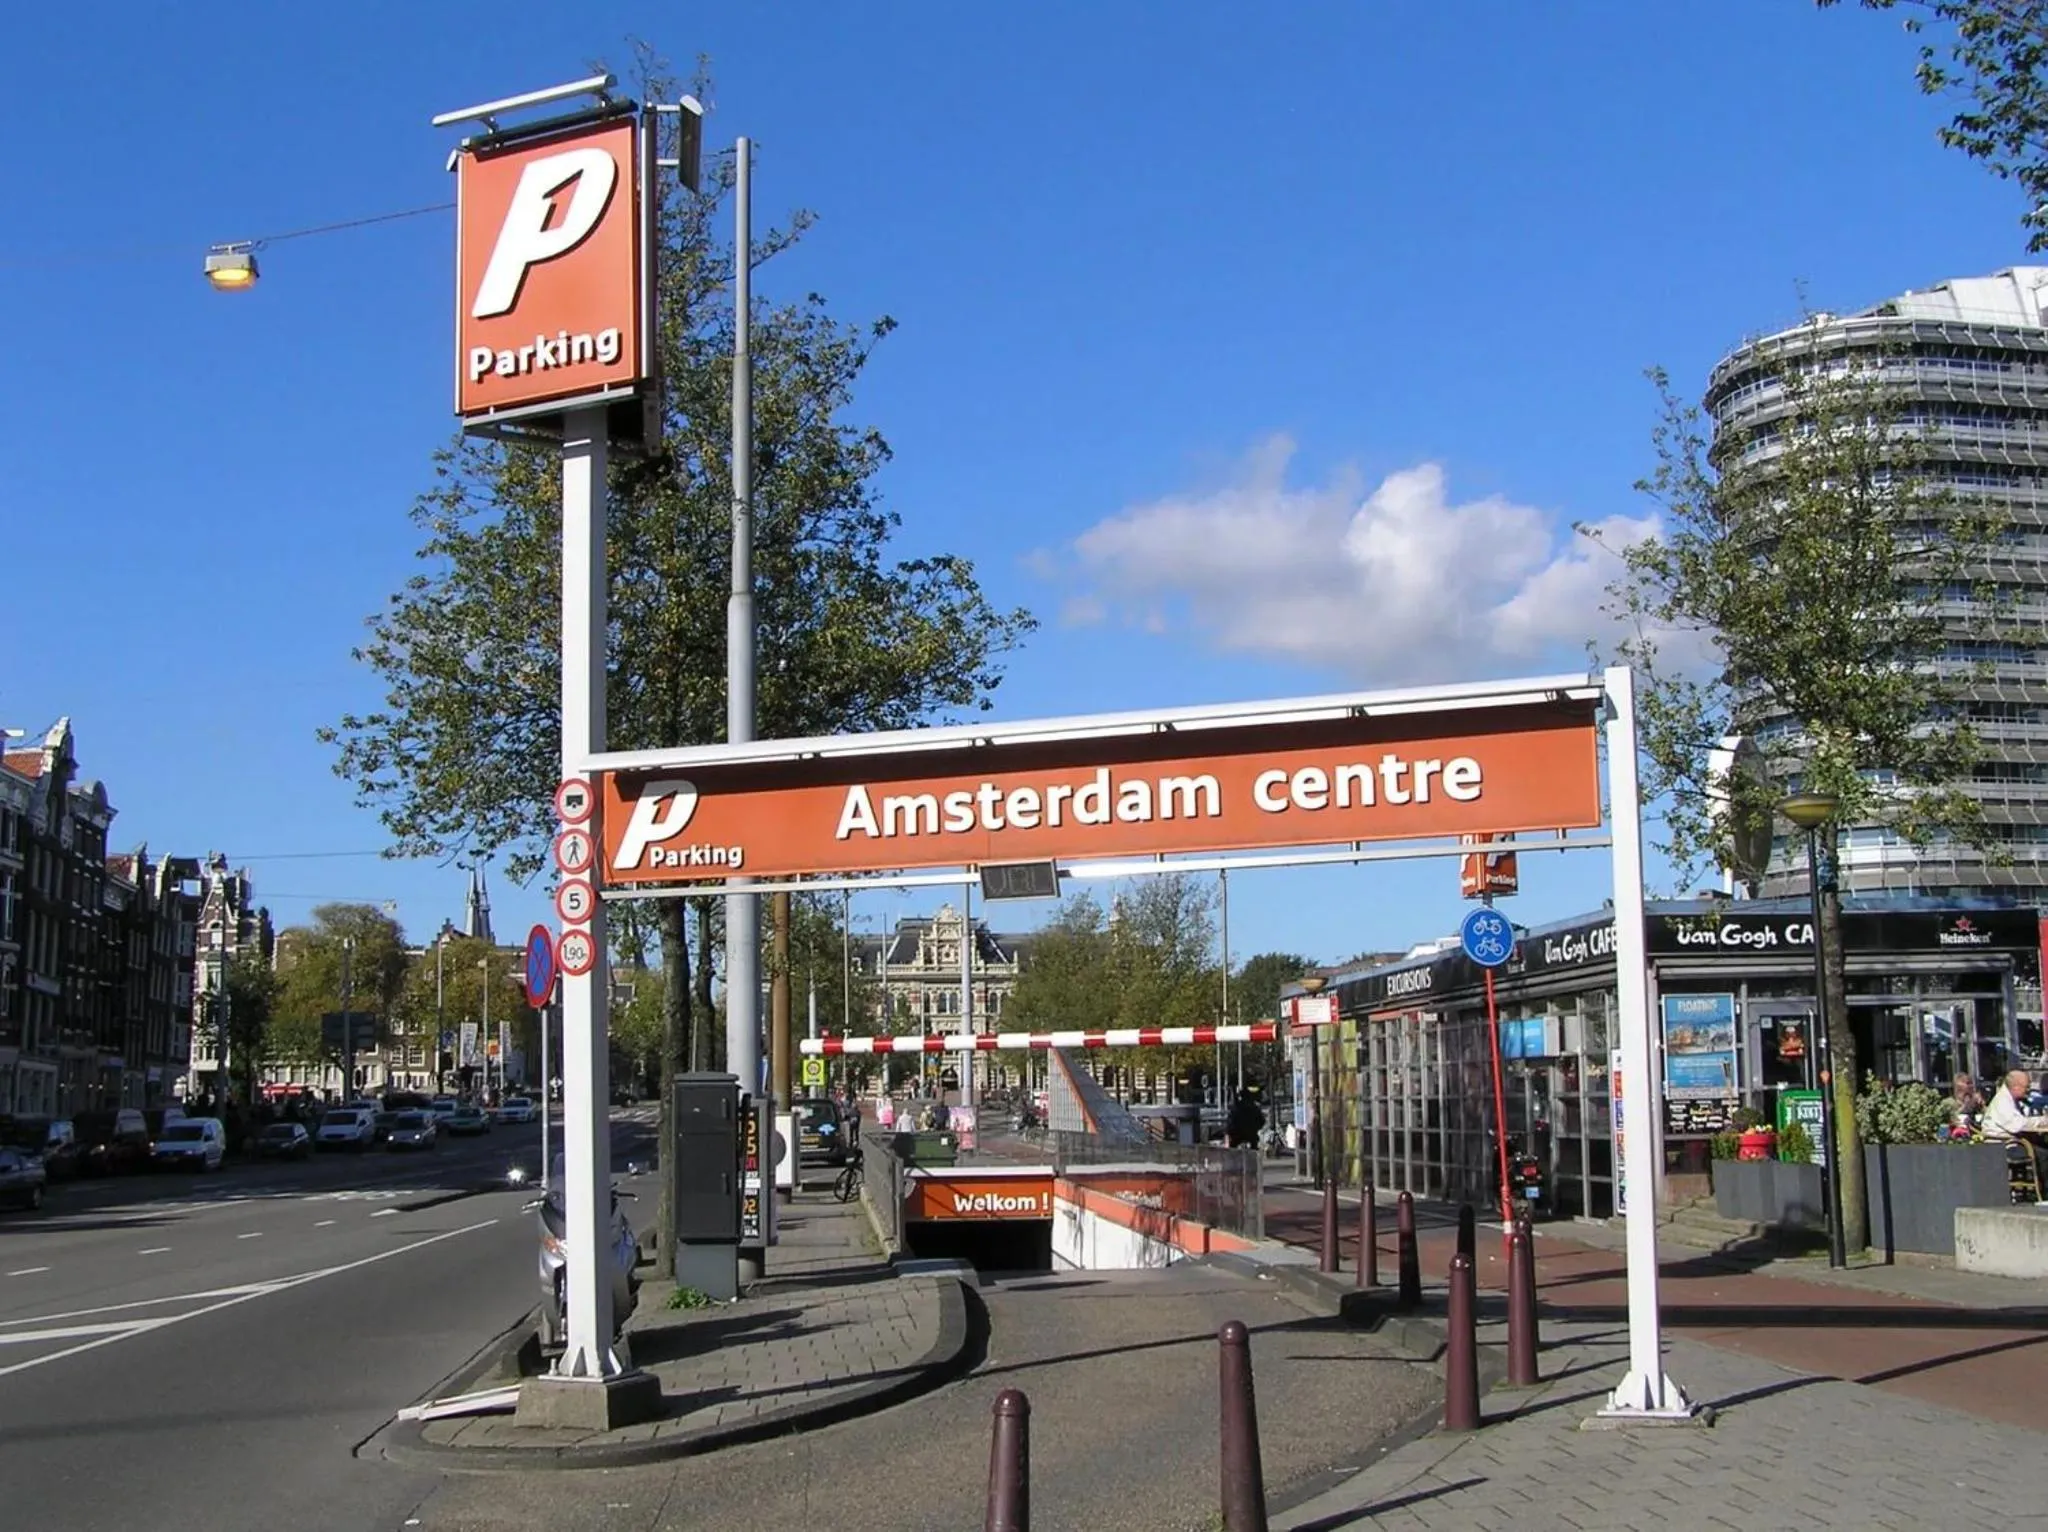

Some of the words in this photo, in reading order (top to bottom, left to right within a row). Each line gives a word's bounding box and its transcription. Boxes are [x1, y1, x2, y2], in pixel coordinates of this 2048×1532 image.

[472, 147, 617, 319] P
[470, 327, 619, 382] Parking
[836, 768, 1221, 840] Amsterdam
[1253, 753, 1483, 813] centre
[612, 779, 698, 869] P
[650, 844, 743, 868] Parking
[569, 892, 581, 910] 5
[1562, 934, 1588, 963] Gogh
[1677, 923, 1716, 945] Van
[1720, 923, 1778, 949] Gogh
[1785, 924, 1815, 945] CA
[1940, 932, 1990, 944] Heineken
[1386, 967, 1431, 996] EXCURSIONS
[953, 1192, 1036, 1212] Welkom
